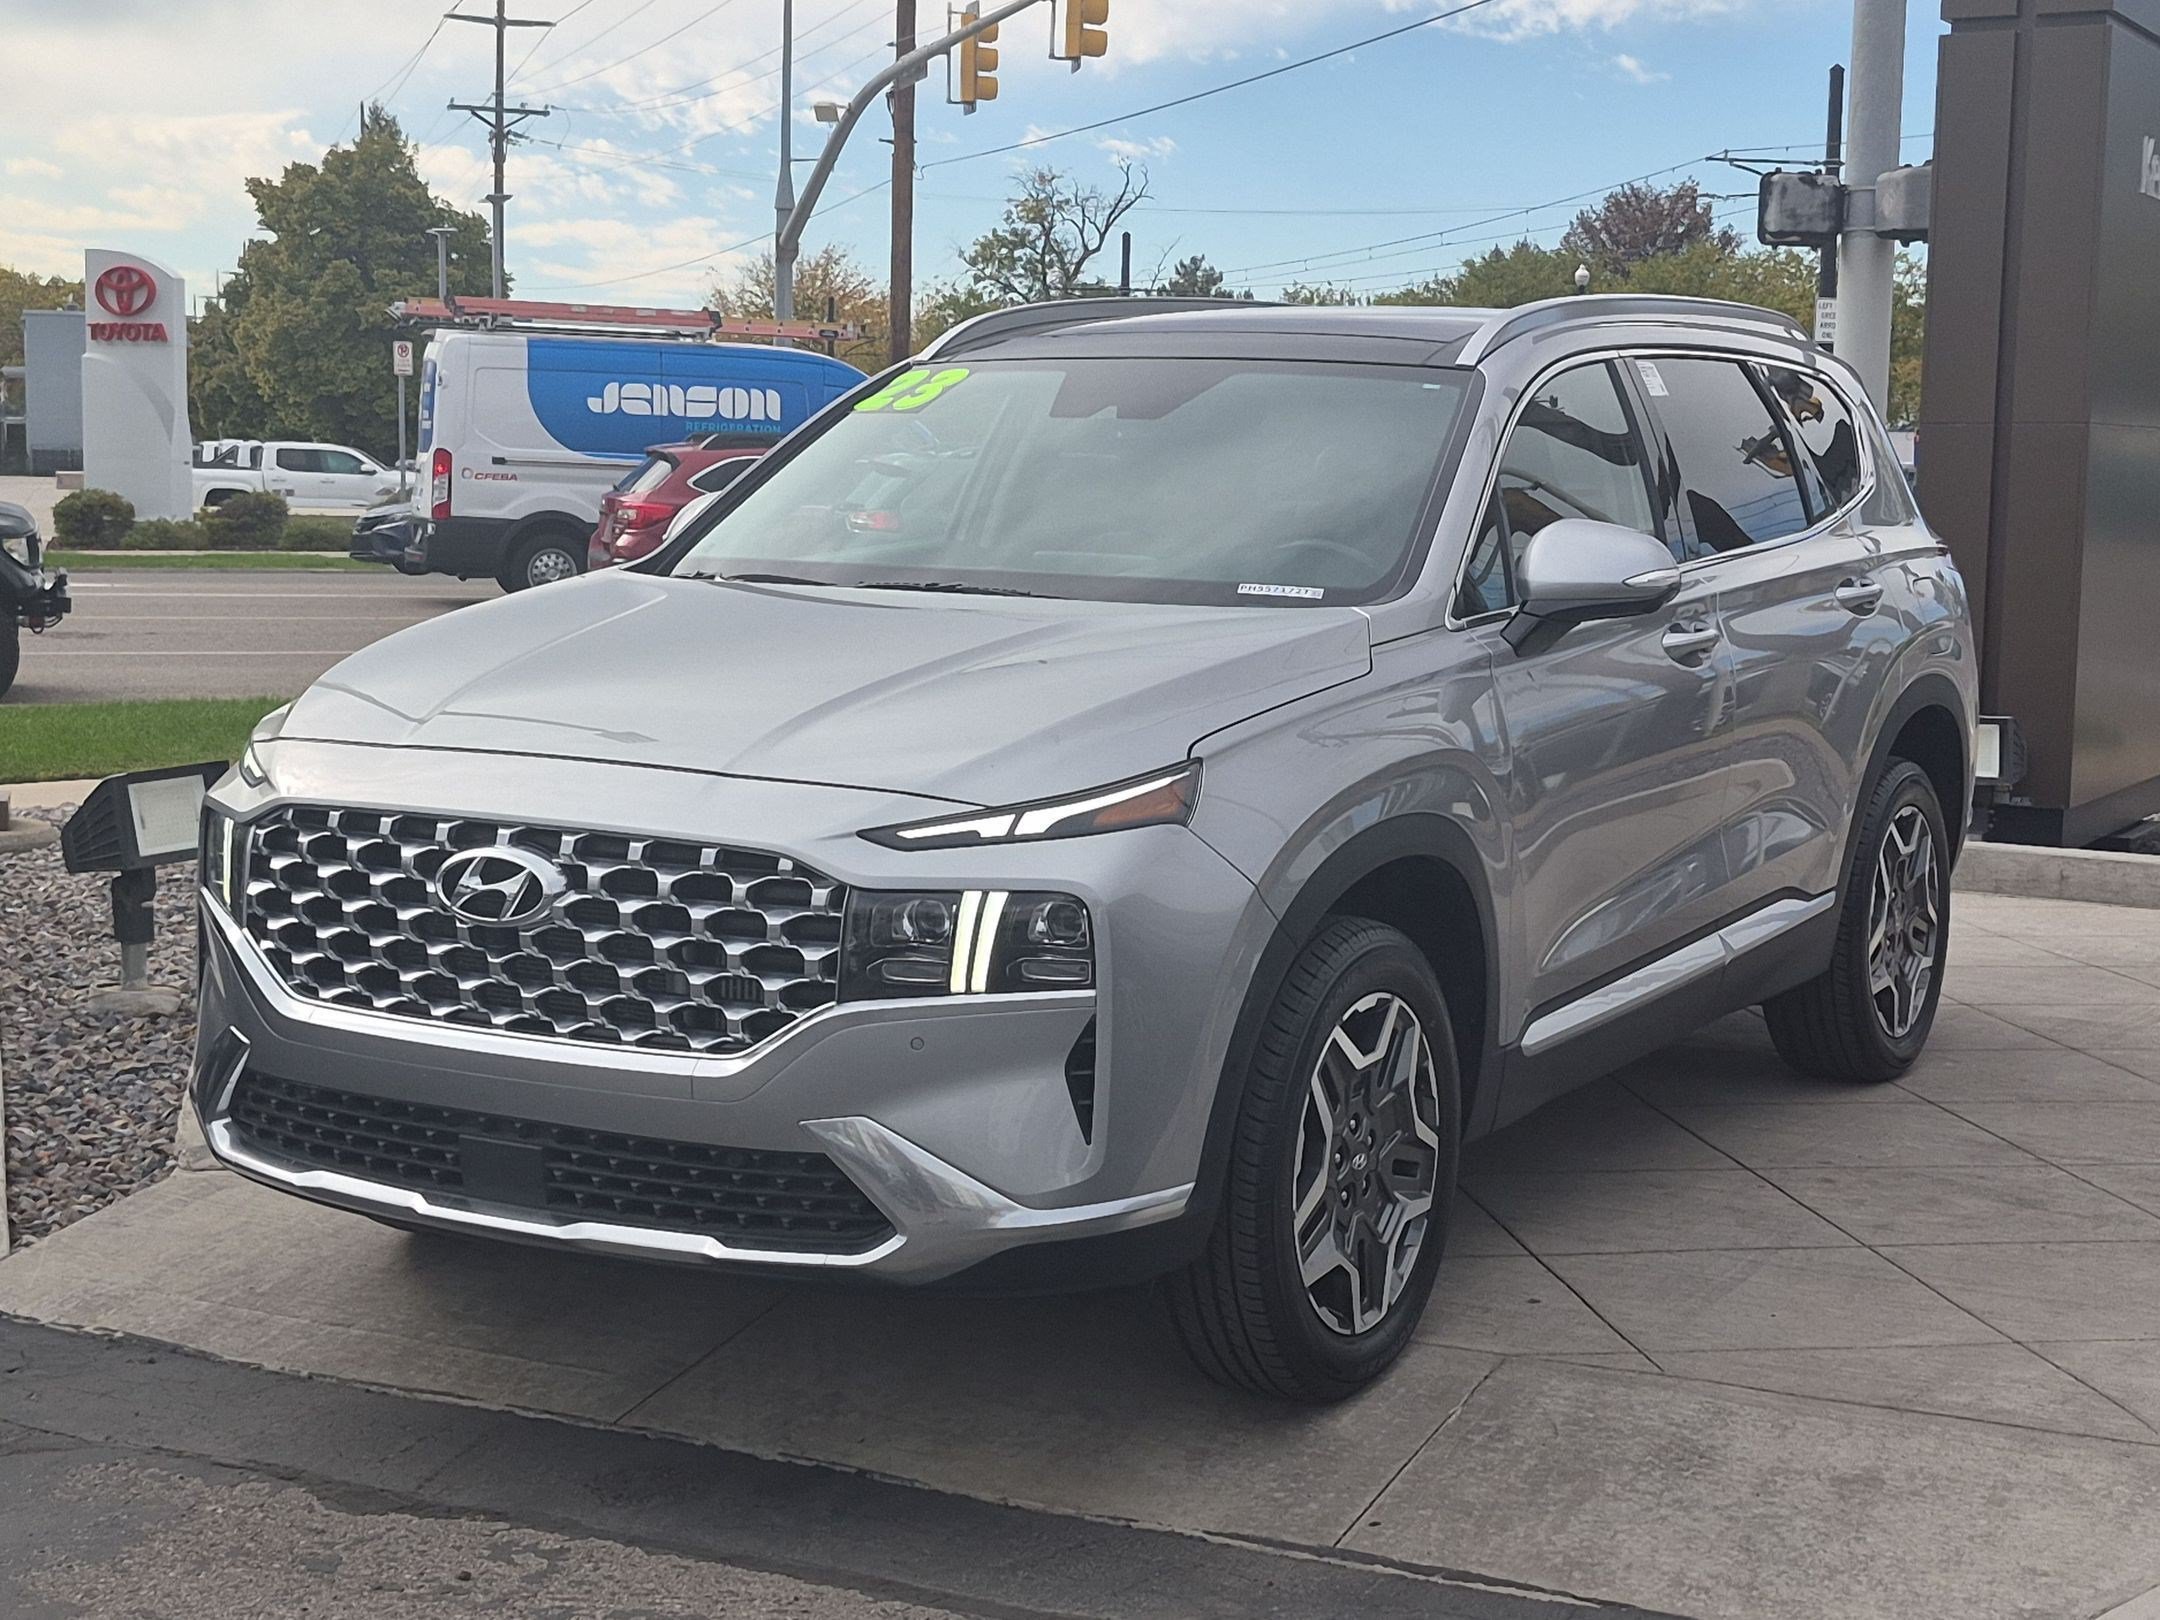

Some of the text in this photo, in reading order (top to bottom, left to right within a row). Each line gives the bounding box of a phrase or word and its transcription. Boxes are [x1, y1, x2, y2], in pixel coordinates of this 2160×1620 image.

[87, 322, 168, 343] TOYOTA
[853, 368, 970, 411] 23
[685, 421, 781, 433] REFRIGERATION
